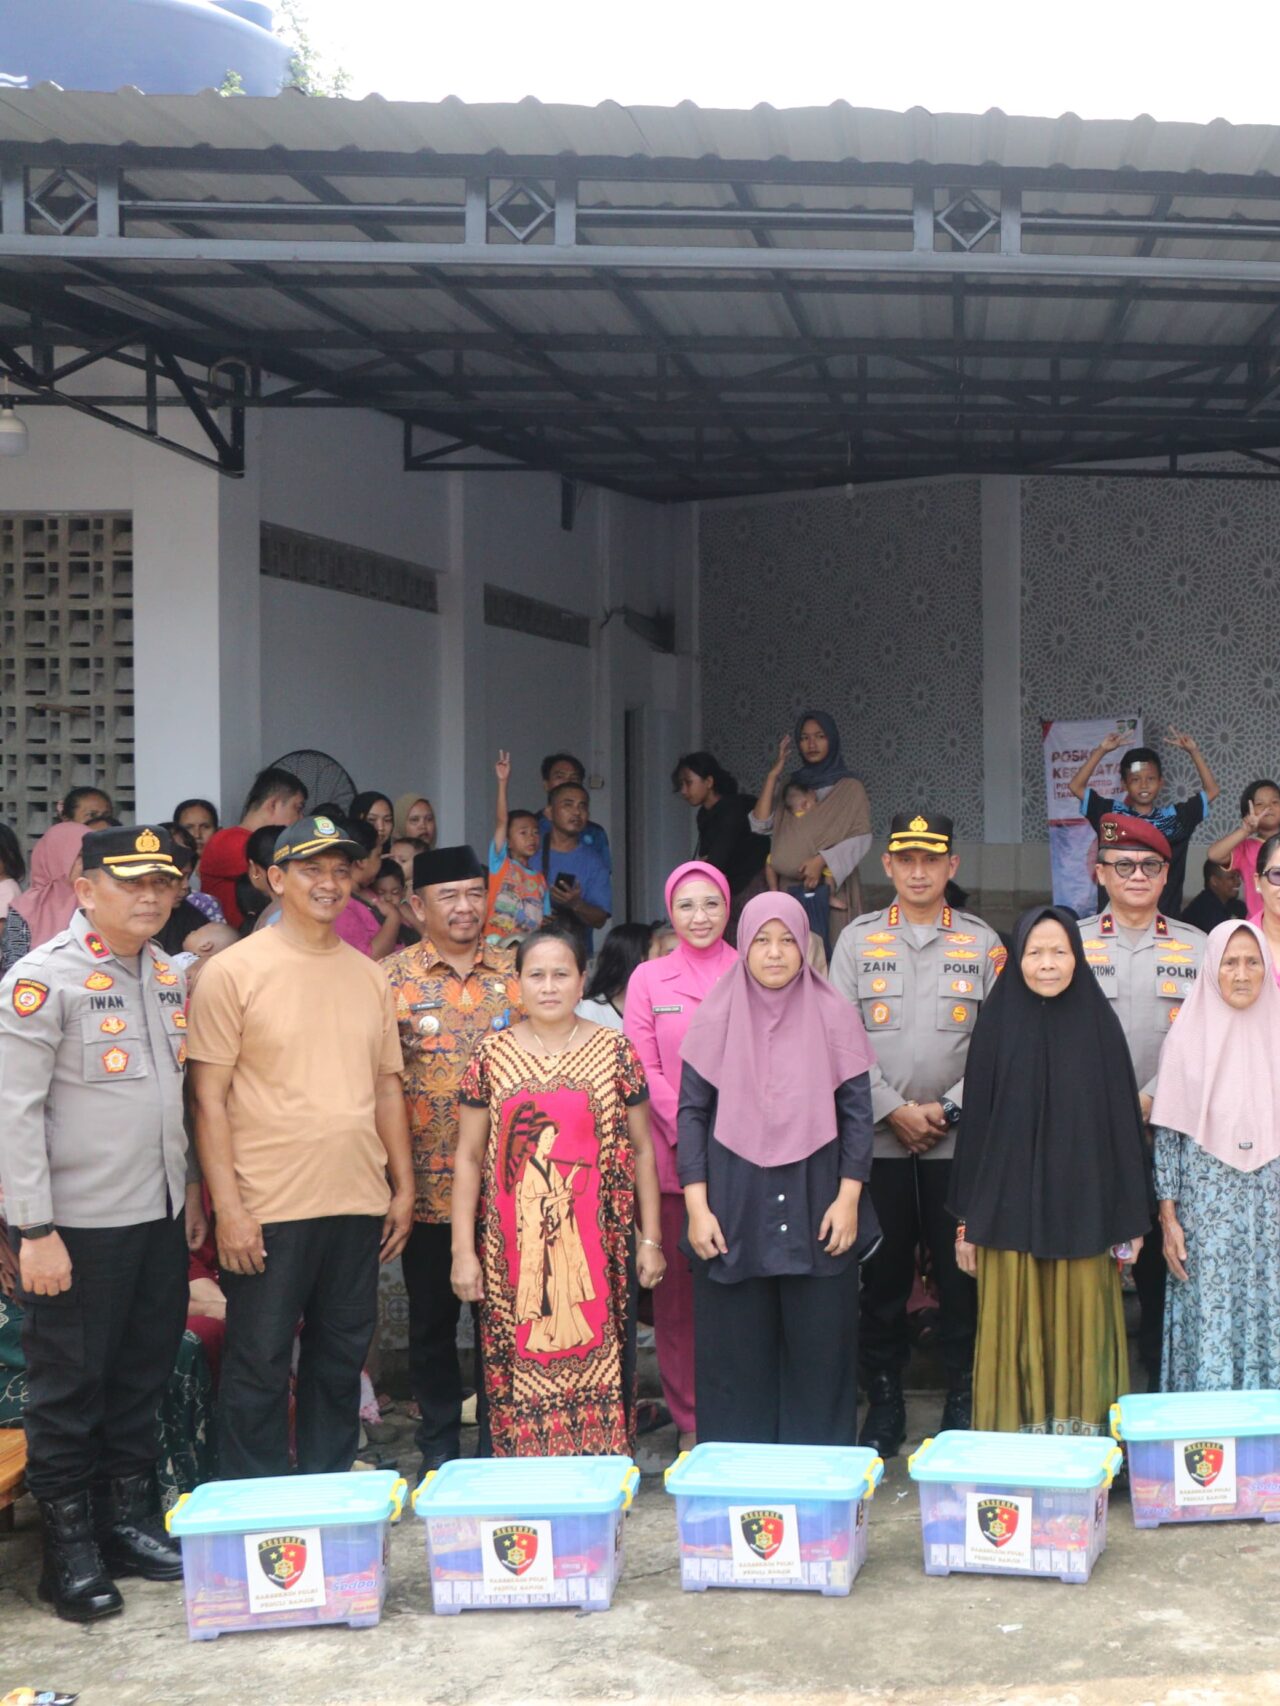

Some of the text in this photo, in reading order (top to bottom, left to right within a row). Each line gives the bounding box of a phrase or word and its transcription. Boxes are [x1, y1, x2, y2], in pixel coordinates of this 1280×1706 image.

[1051, 749, 1091, 763] POSK
[863, 962, 897, 973] ZAIN
[943, 963, 980, 975] POLRI
[1156, 966, 1197, 979] POLRI
[90, 995, 125, 1010] IWAN
